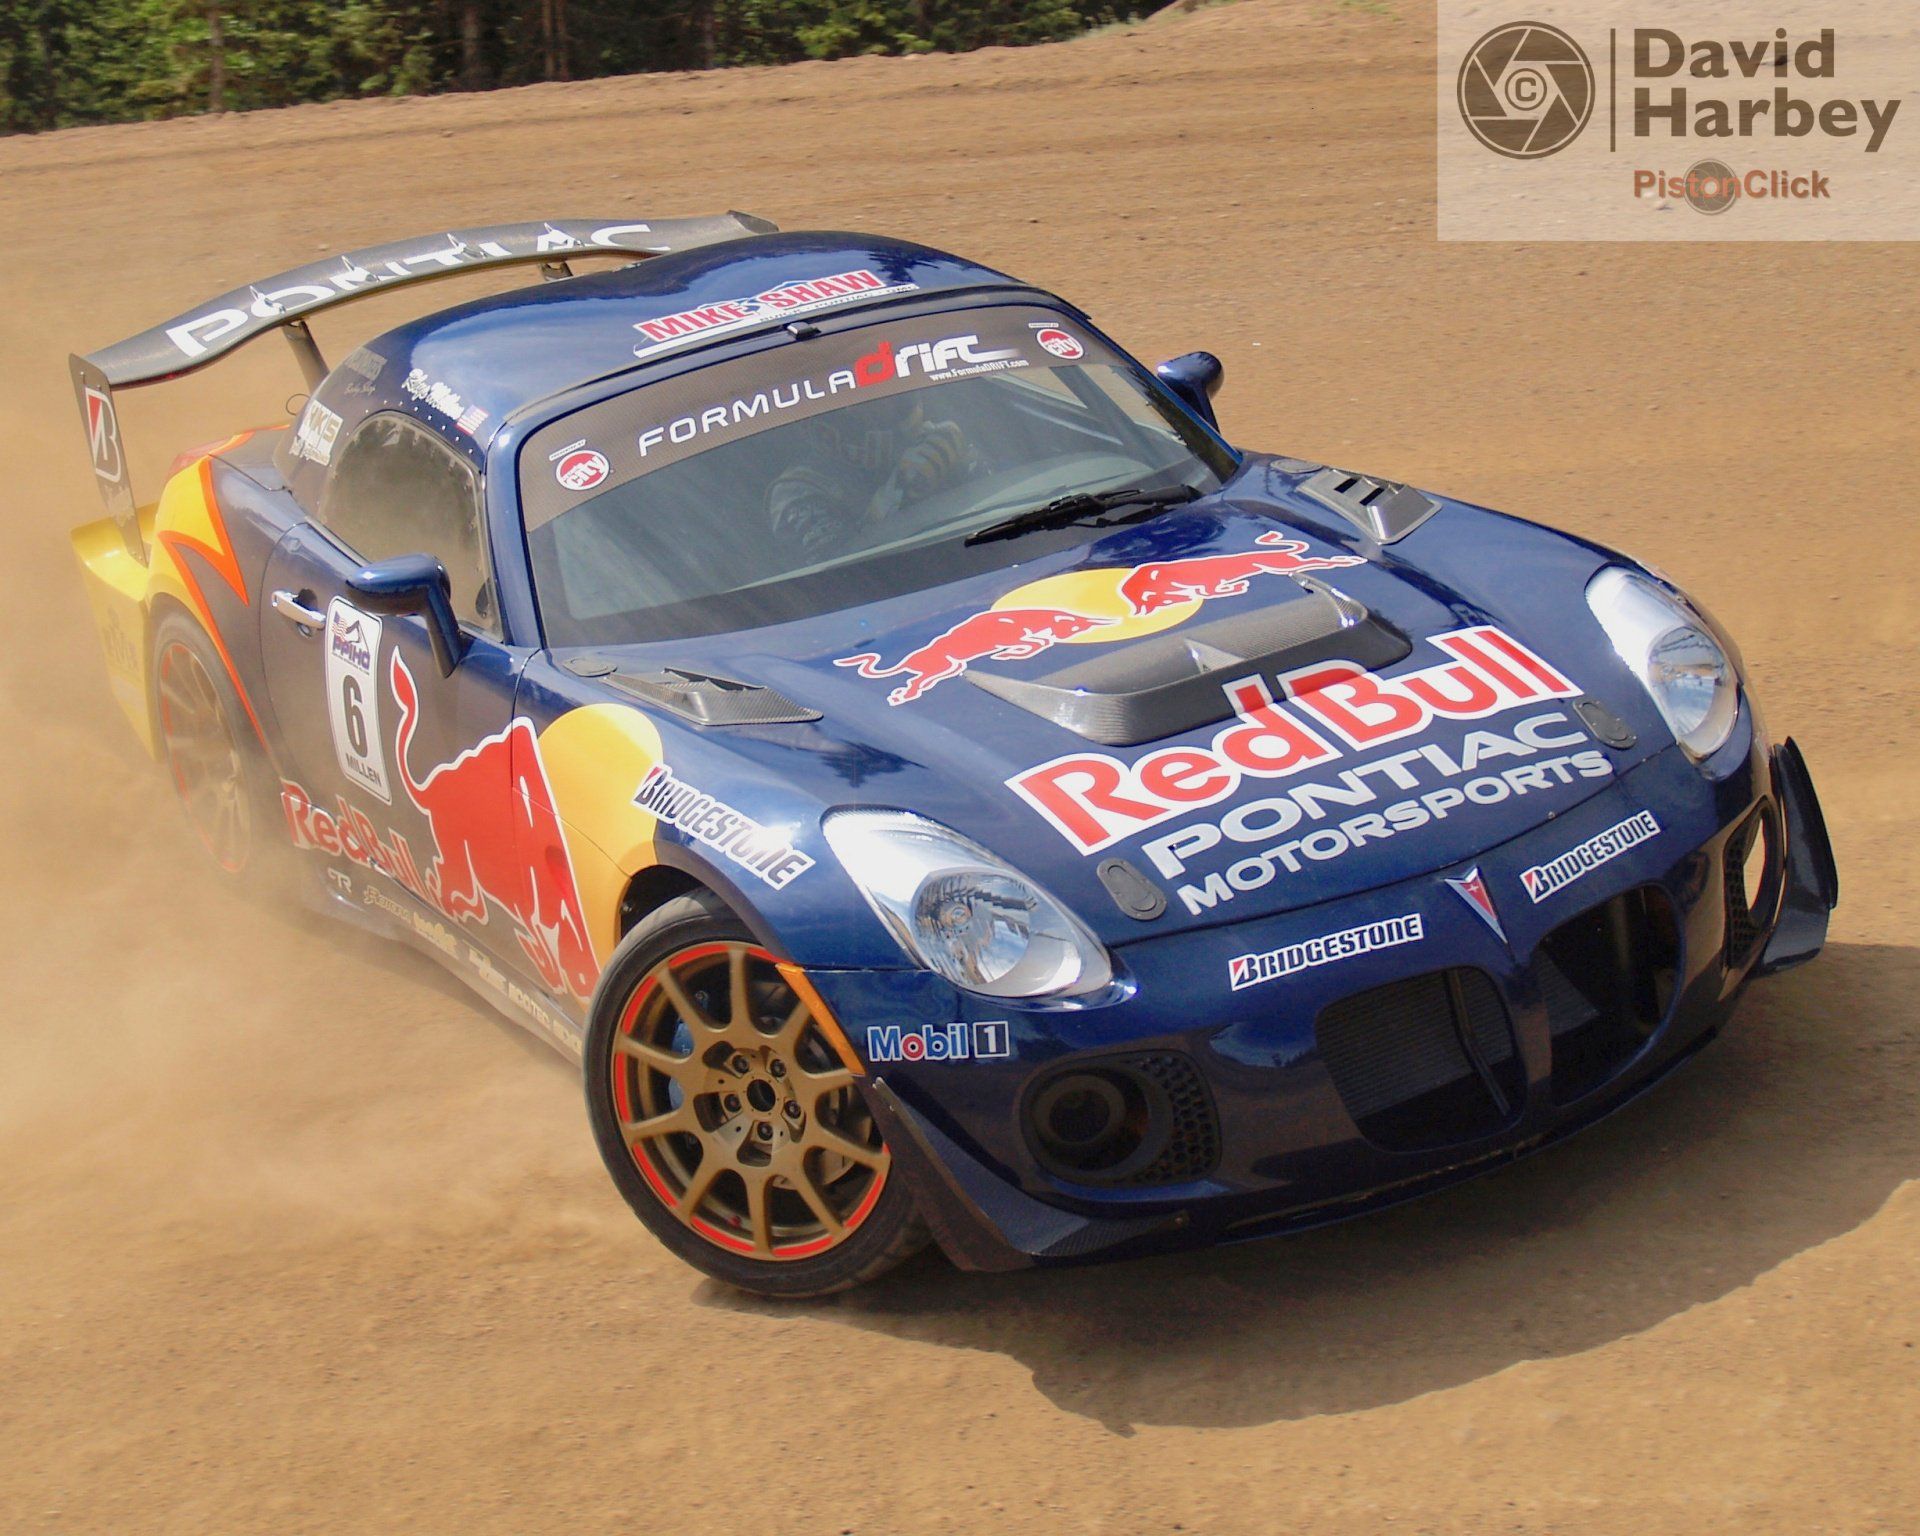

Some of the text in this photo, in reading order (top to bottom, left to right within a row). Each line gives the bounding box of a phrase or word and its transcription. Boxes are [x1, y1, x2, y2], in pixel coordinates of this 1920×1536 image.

[640, 270, 882, 341] MIKE SHAW
[638, 373, 855, 457] FORMULA
[343, 674, 368, 758] 6
[346, 753, 381, 787] MILLEN
[1142, 713, 1588, 879] PONTIAC
[636, 765, 810, 885] BRIDGESTONE
[1177, 750, 1613, 915] MOTORSPORTS
[1522, 811, 1659, 902] BRIDGESTONE
[1230, 915, 1422, 988] BRIDGESTONE
[868, 1024, 968, 1061] Mobil
